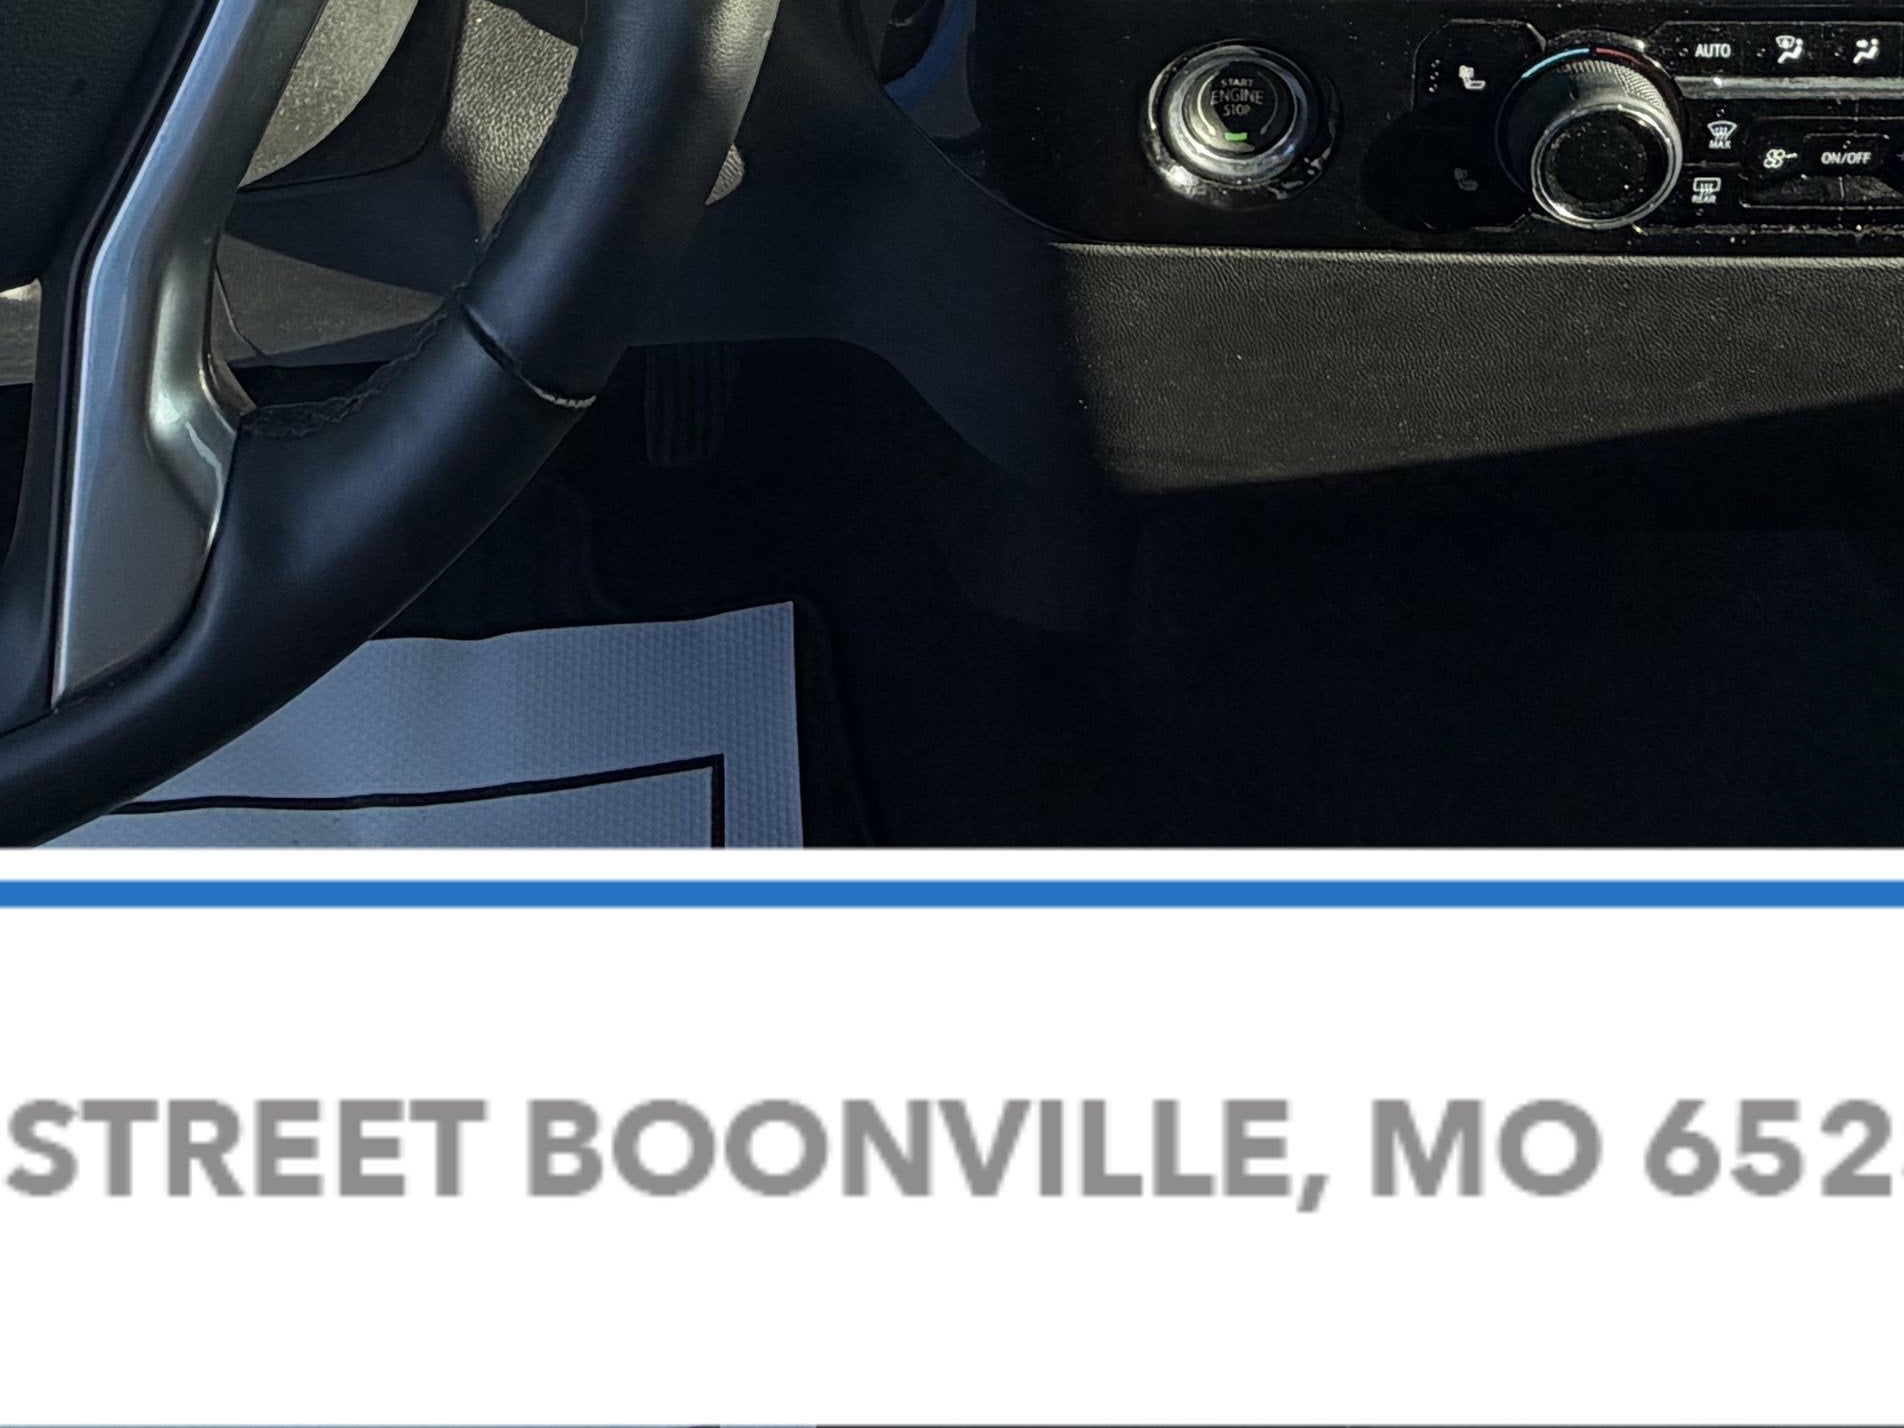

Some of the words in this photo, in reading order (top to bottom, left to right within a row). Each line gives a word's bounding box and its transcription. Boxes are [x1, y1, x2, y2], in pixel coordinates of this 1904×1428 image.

[1695, 44, 1731, 58] AUTO
[1221, 78, 1253, 87] START
[1210, 88, 1263, 106] ENGINE
[1223, 104, 1250, 116] STOP
[1709, 140, 1731, 149] MAX
[1821, 152, 1871, 165] ON/OFF
